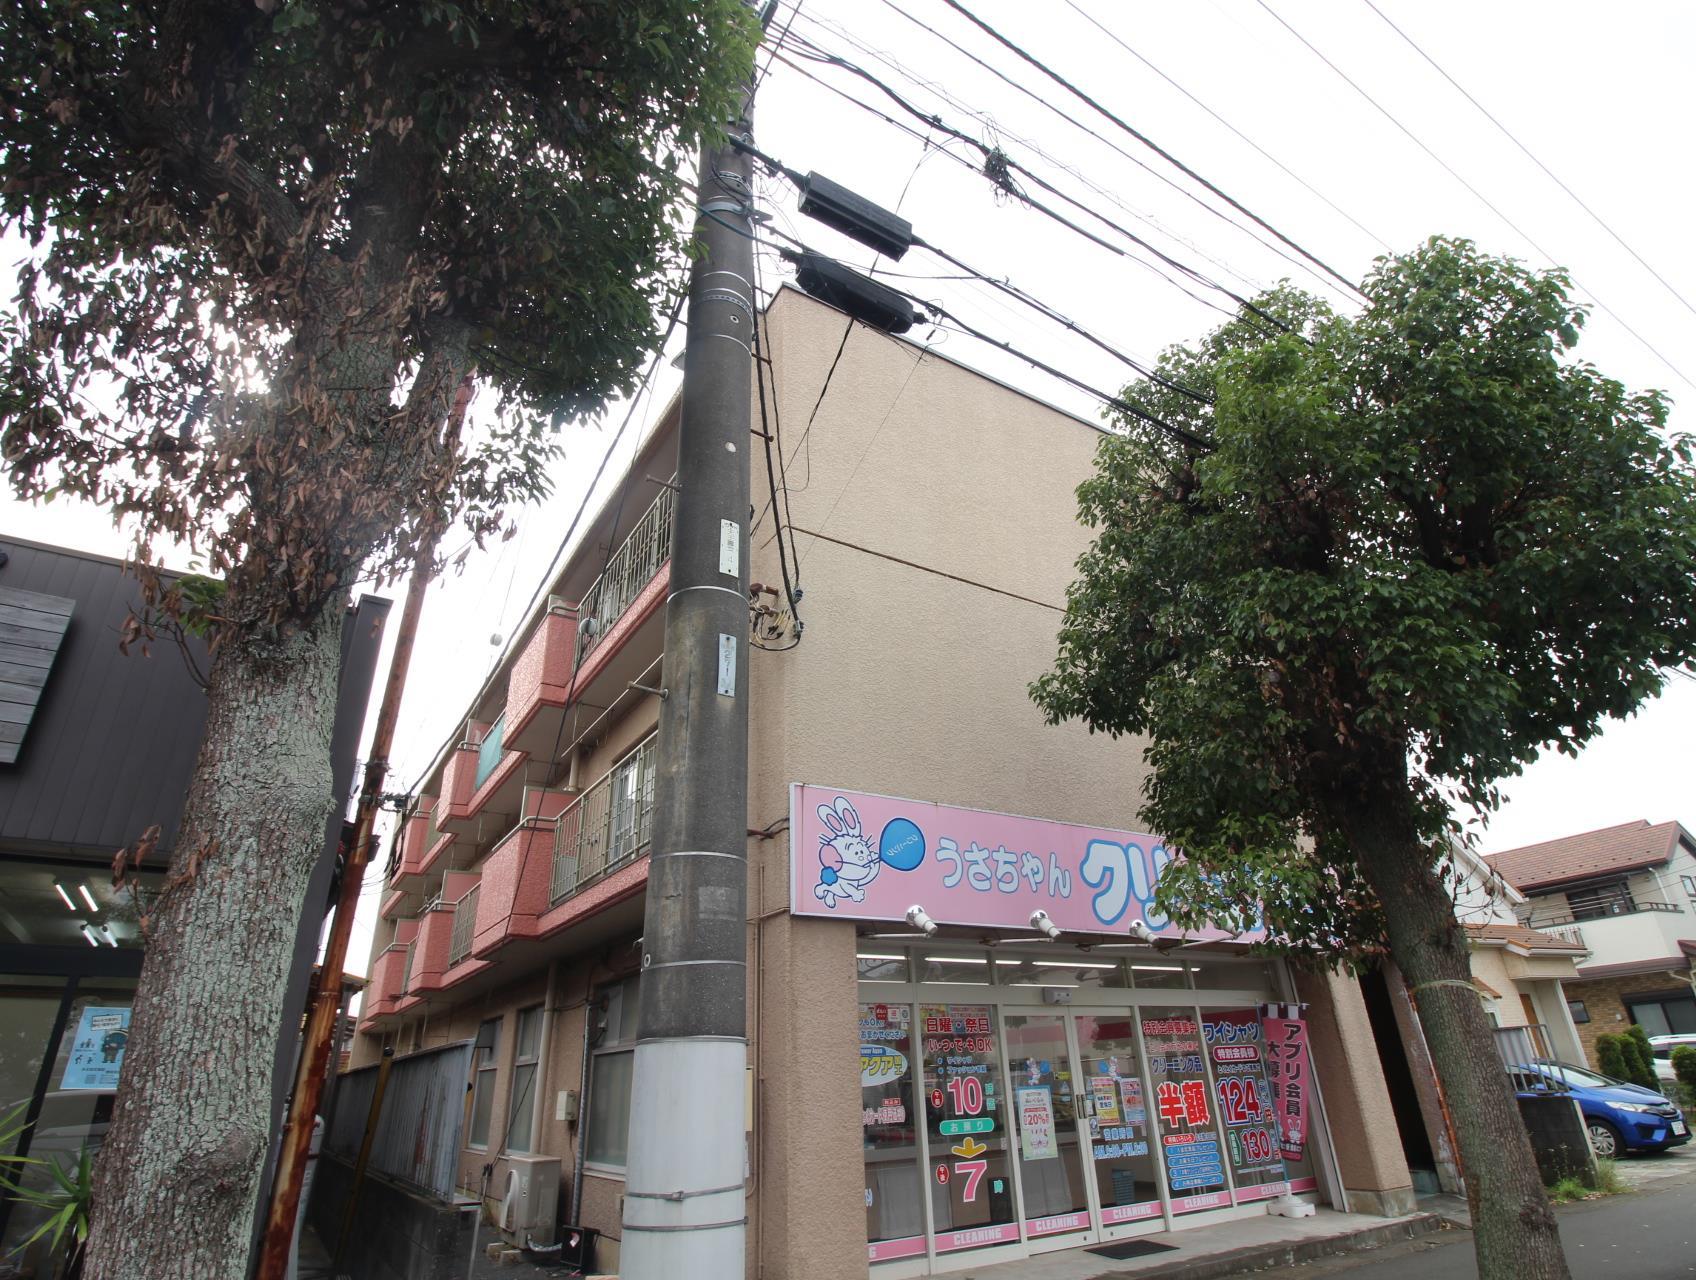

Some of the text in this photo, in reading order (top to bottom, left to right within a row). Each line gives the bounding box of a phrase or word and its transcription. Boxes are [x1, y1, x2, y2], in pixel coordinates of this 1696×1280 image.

[936, 837, 1072, 899] うさちゃん
[1203, 1021, 1259, 1043] ワイシャツ
[1283, 1023, 1302, 1117] アプリ会員
[947, 1076, 983, 1115] 10
[1157, 1080, 1210, 1128] 半額
[1216, 1076, 1263, 1126] 124
[1241, 1127, 1272, 1163] 130
[954, 1160, 988, 1202] 7
[953, 1227, 1002, 1246] CLEANING
[1035, 1215, 1079, 1232] CLEANING
